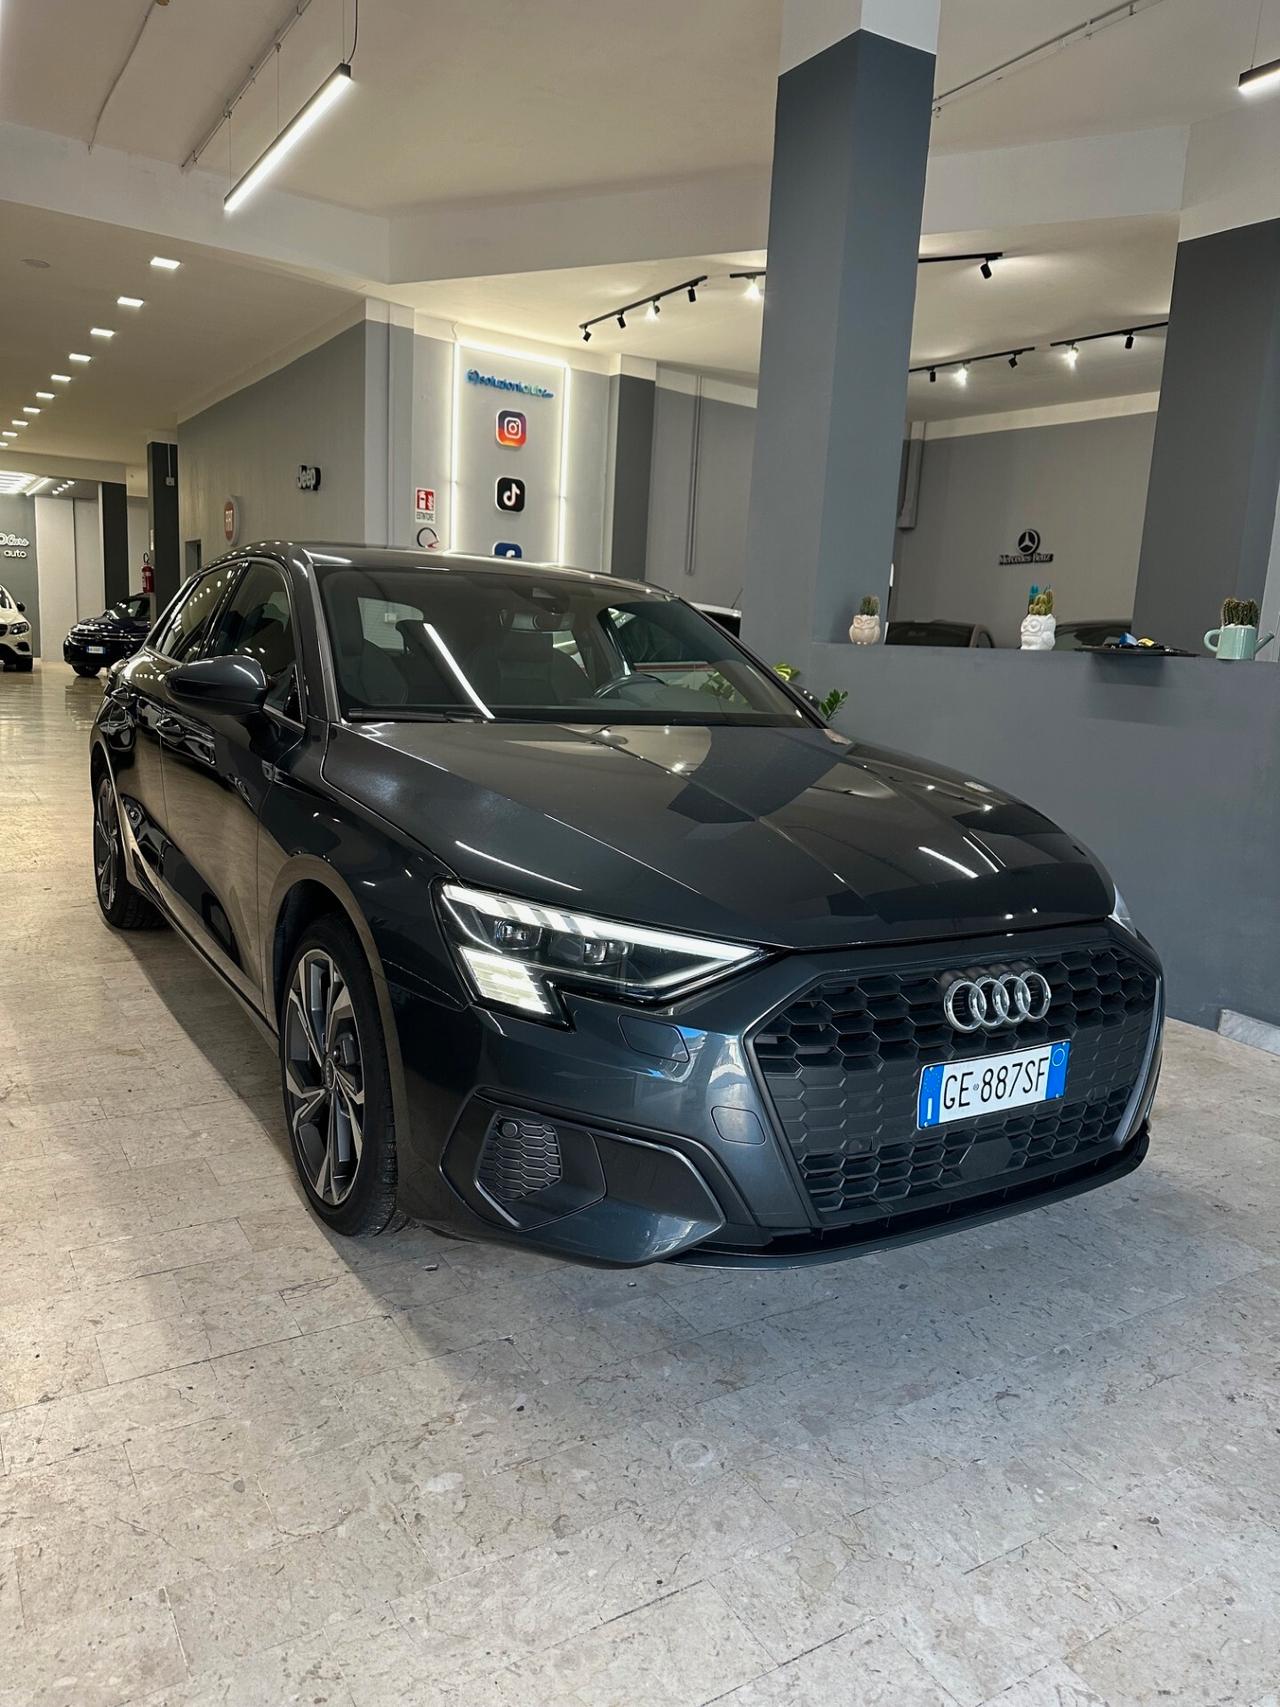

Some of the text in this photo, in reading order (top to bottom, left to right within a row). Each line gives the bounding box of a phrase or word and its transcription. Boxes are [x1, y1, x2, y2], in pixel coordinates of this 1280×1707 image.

[297, 465, 319, 491] Jeep
[4, 549, 27, 558] auto
[943, 1056, 1050, 1110] GE 887SF
